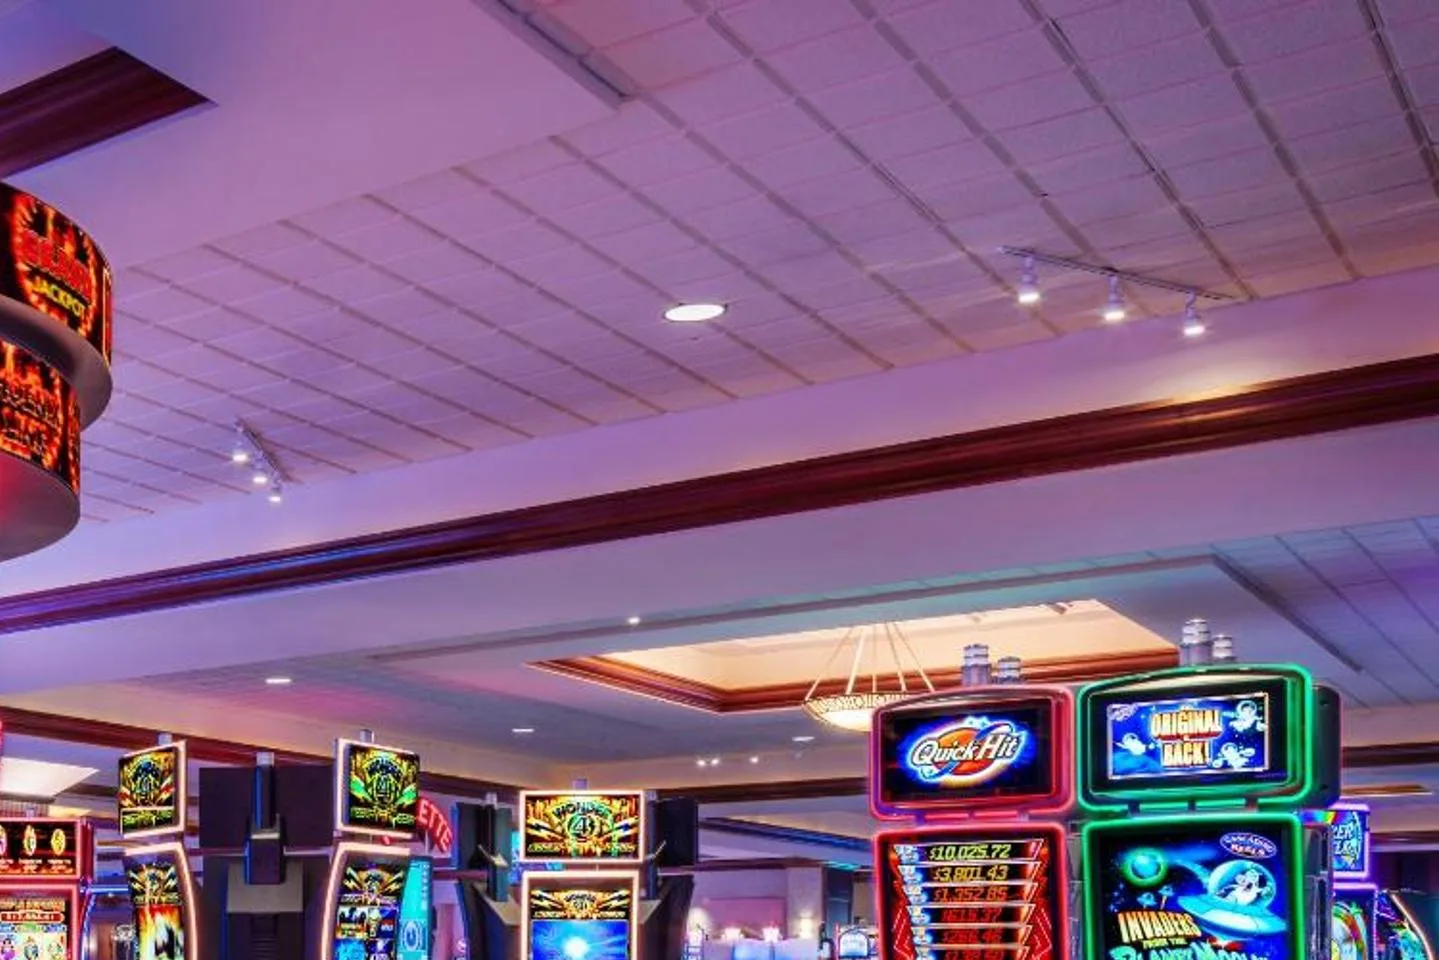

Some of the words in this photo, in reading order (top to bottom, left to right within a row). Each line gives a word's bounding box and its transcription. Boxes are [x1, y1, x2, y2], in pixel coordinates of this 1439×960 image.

[32, 278, 85, 317] JACKPOT
[1151, 709, 1223, 740] ORIGINAL
[912, 738, 979, 766] Quick
[975, 731, 1020, 760] Hit
[1162, 740, 1210, 768] BACK!
[1118, 911, 1203, 944] INVADERS
